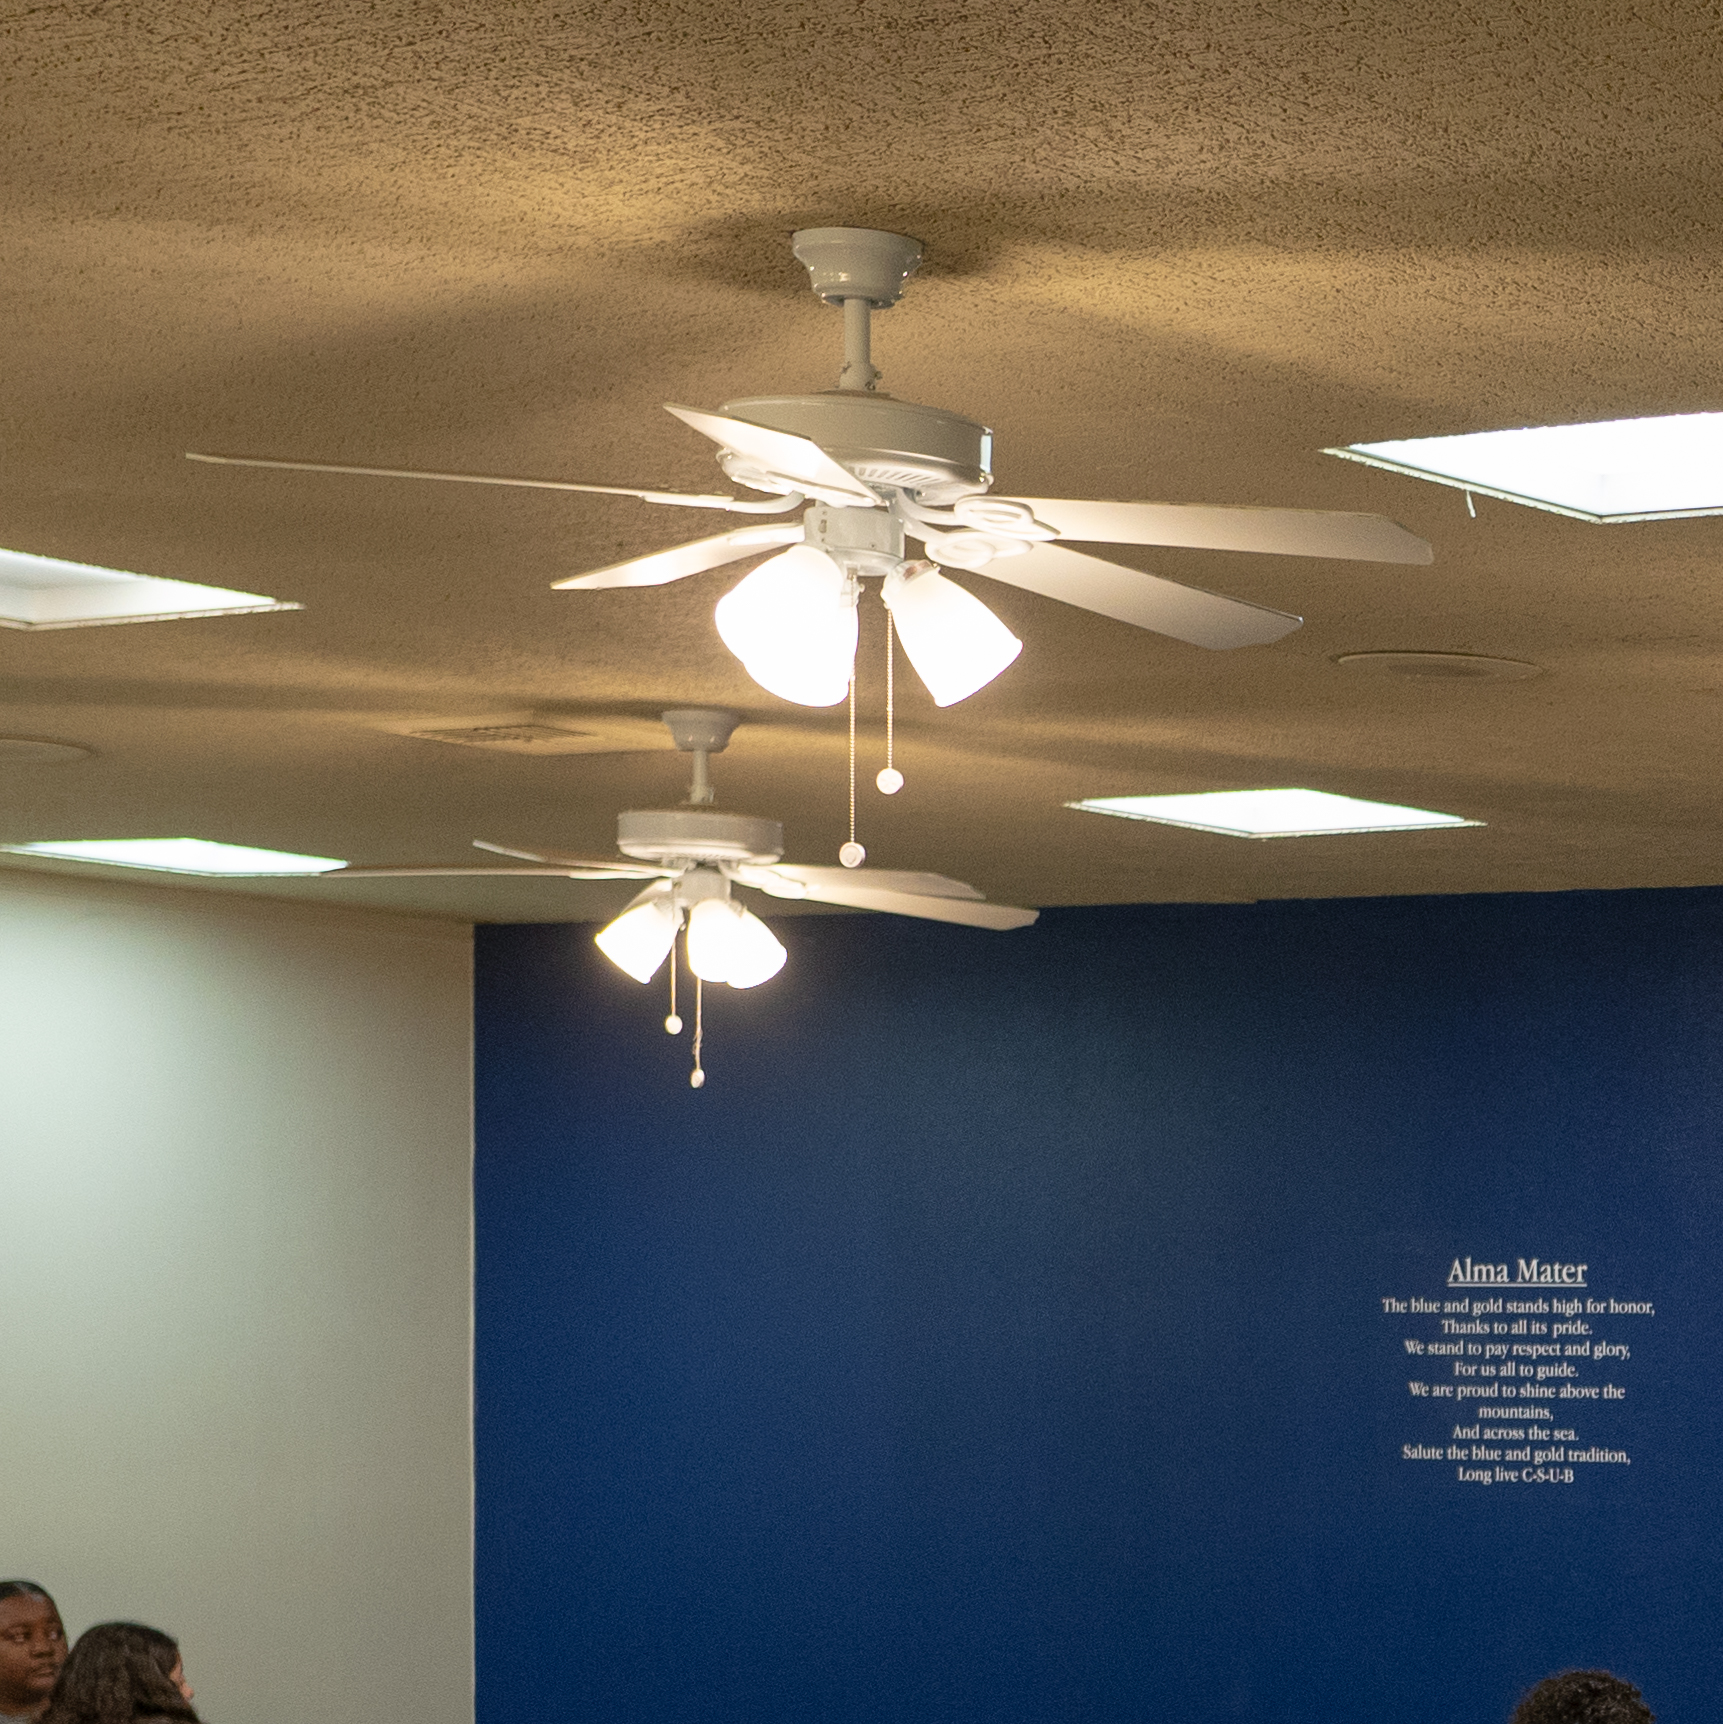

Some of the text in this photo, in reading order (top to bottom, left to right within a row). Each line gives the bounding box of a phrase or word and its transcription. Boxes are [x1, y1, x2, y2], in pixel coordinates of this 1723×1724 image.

[1447, 1256, 1588, 1284] Alma Mater
[1381, 1298, 1656, 1318] The blue and gold stands high for honor,
[1441, 1319, 1593, 1339] Thanks to all its pride.
[1404, 1340, 1631, 1361] We stand to pay respect and glory,
[1453, 1362, 1579, 1382] For us all to guide.
[1408, 1382, 1626, 1401] We are proud to shine above the
[1478, 1405, 1554, 1424] mountains,
[1452, 1425, 1580, 1441] And across the sea.
[1402, 1445, 1632, 1467] Salute the blue and gold tradition,
[1458, 1466, 1575, 1486] Long live C-S-U-B
